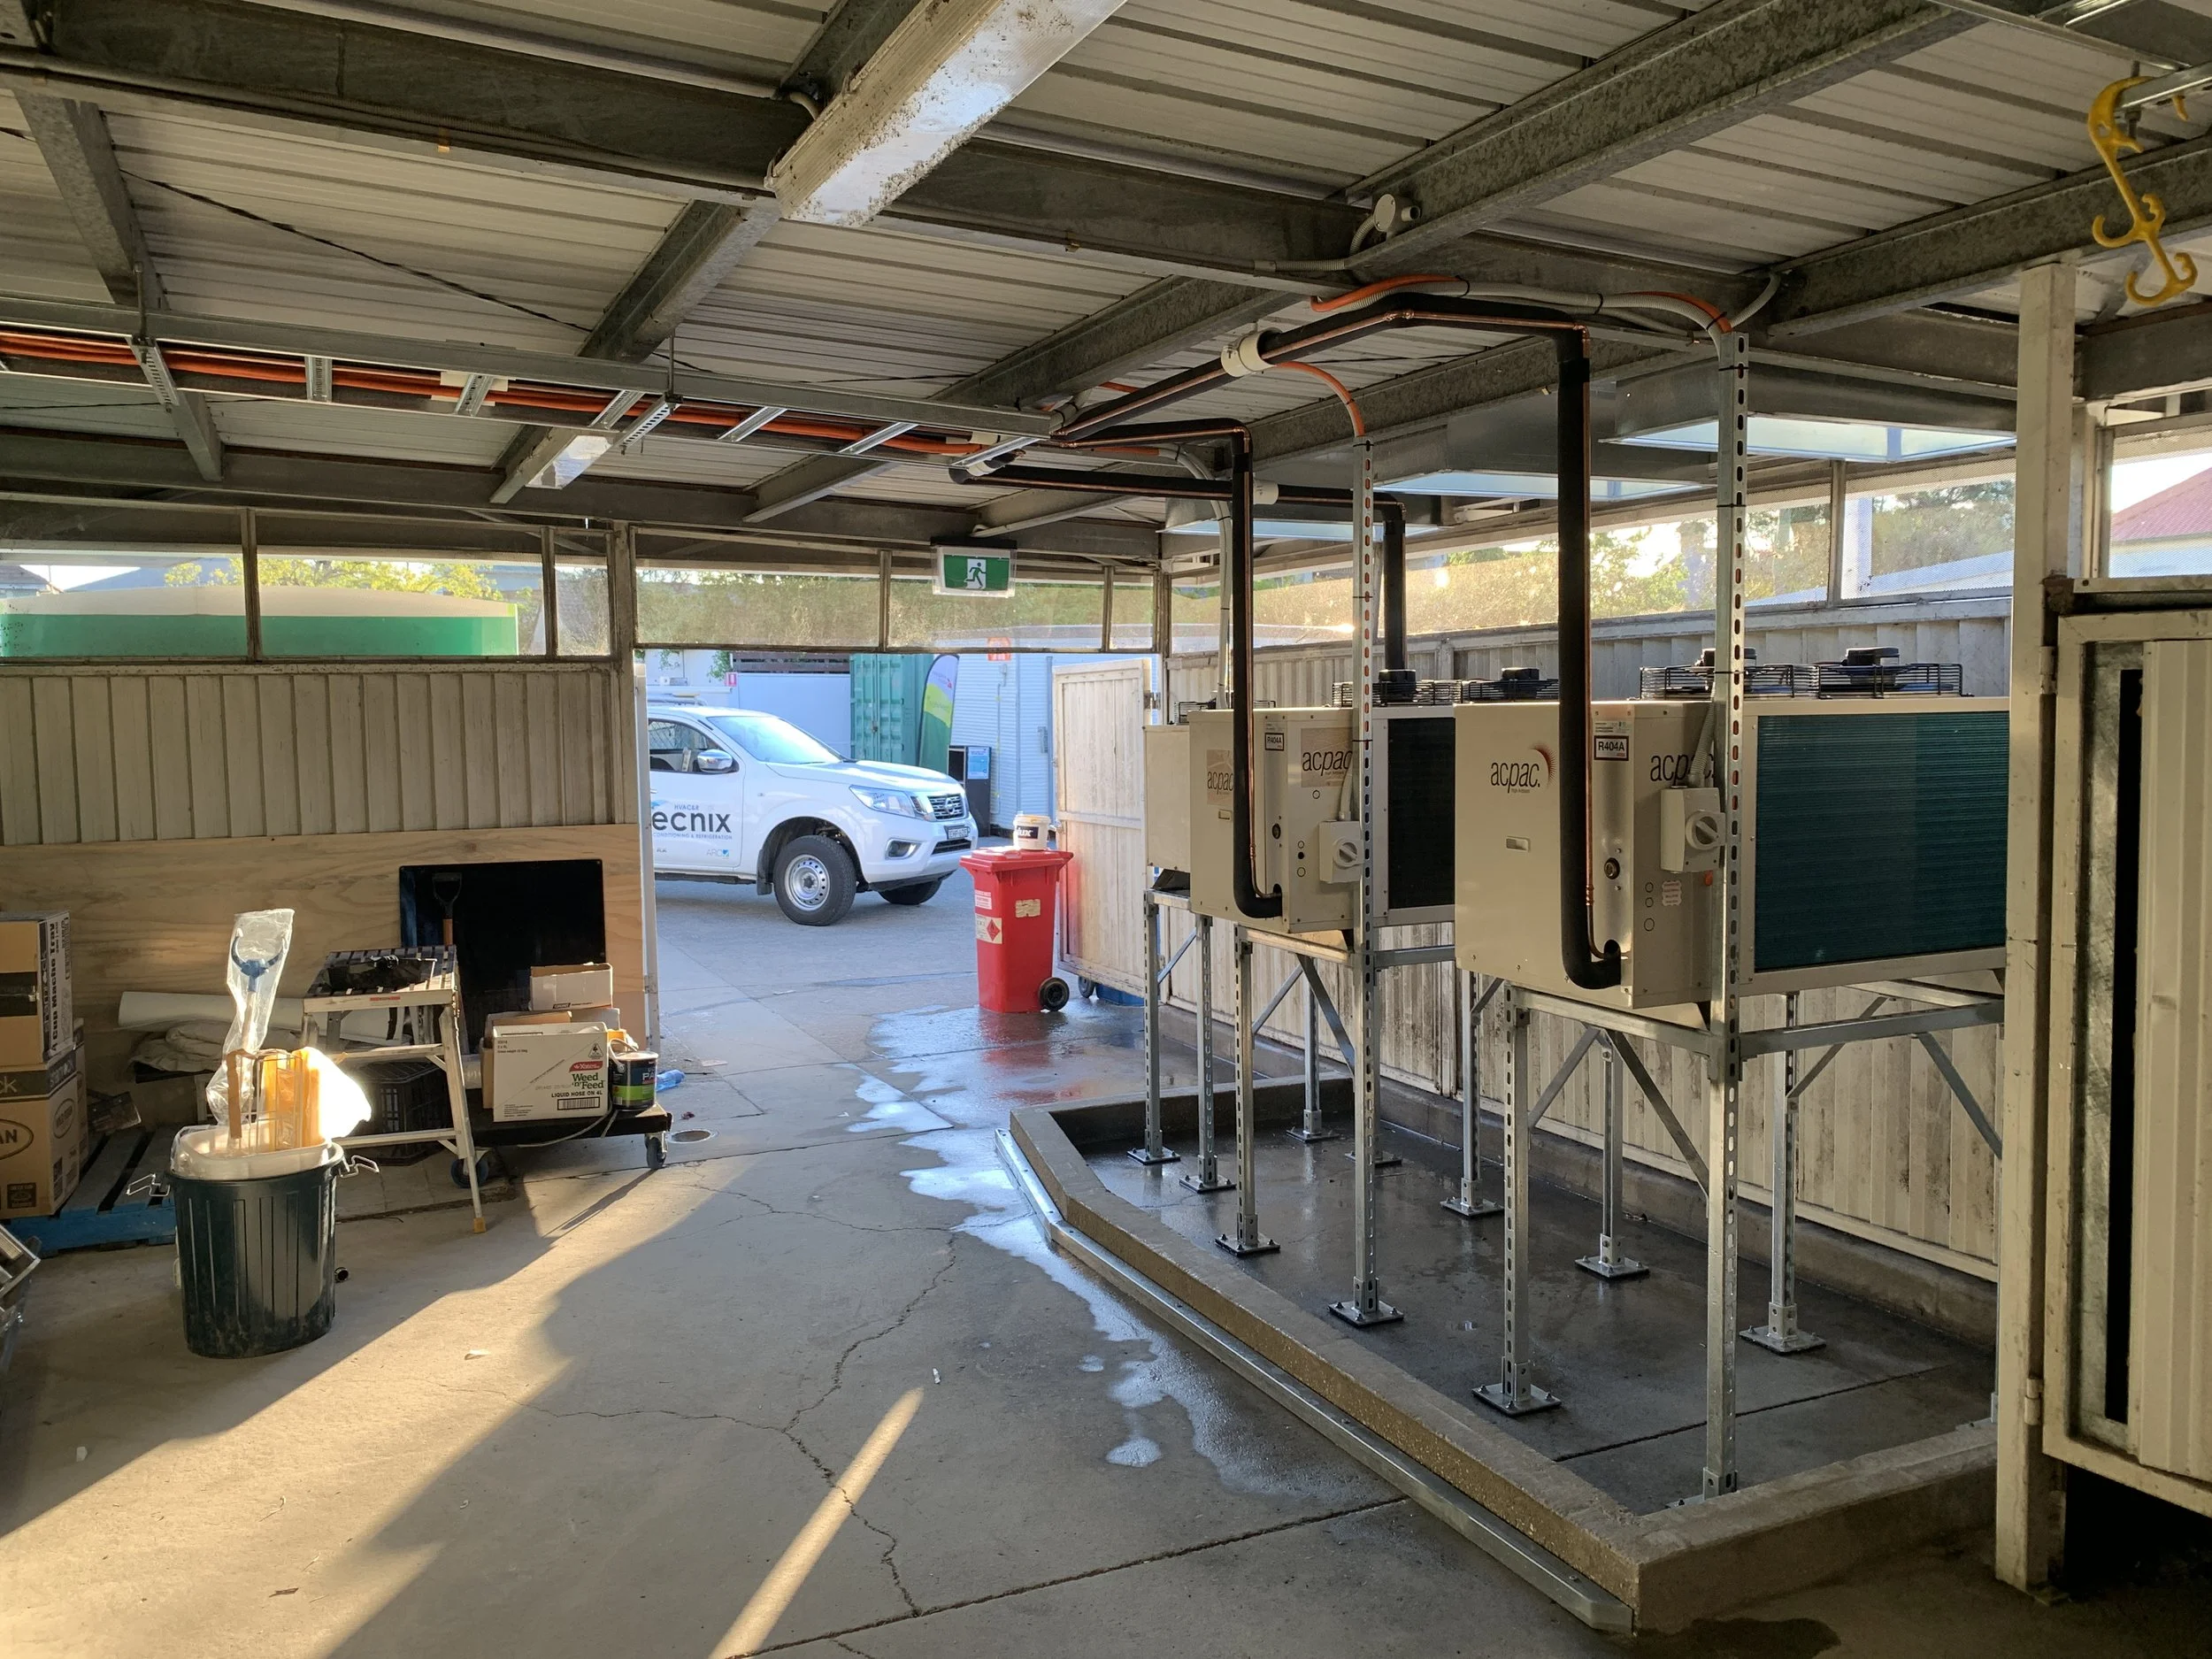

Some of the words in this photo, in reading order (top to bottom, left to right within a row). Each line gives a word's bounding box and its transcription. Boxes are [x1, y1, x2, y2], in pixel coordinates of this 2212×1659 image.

[1598, 741, 1624, 751] R404A
[652, 811, 732, 833] ecnix
[572, 1072, 598, 1081] Weed
[581, 1080, 604, 1089] Feed
